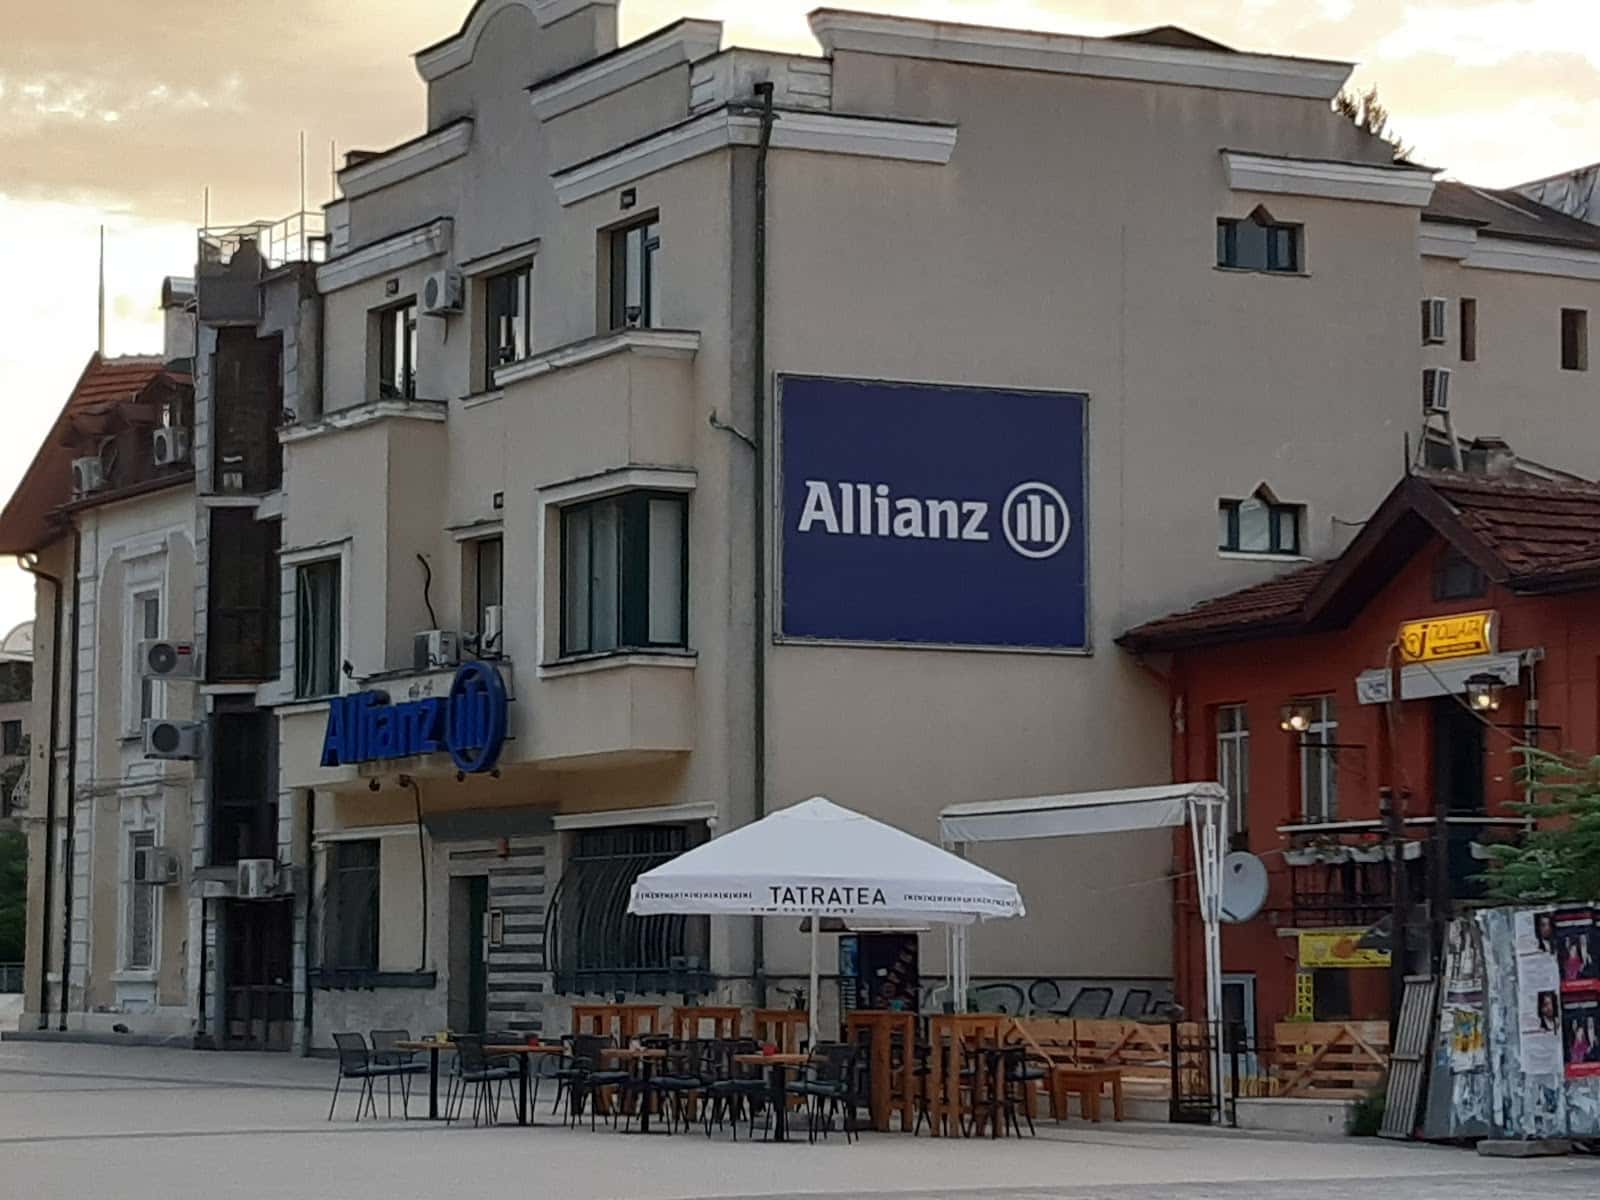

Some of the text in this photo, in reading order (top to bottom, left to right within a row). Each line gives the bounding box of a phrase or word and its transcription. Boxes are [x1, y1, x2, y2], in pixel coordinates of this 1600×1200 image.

[797, 480, 990, 541] Allianz
[320, 689, 446, 767] Allianz
[768, 886, 887, 905] TATRATEA
